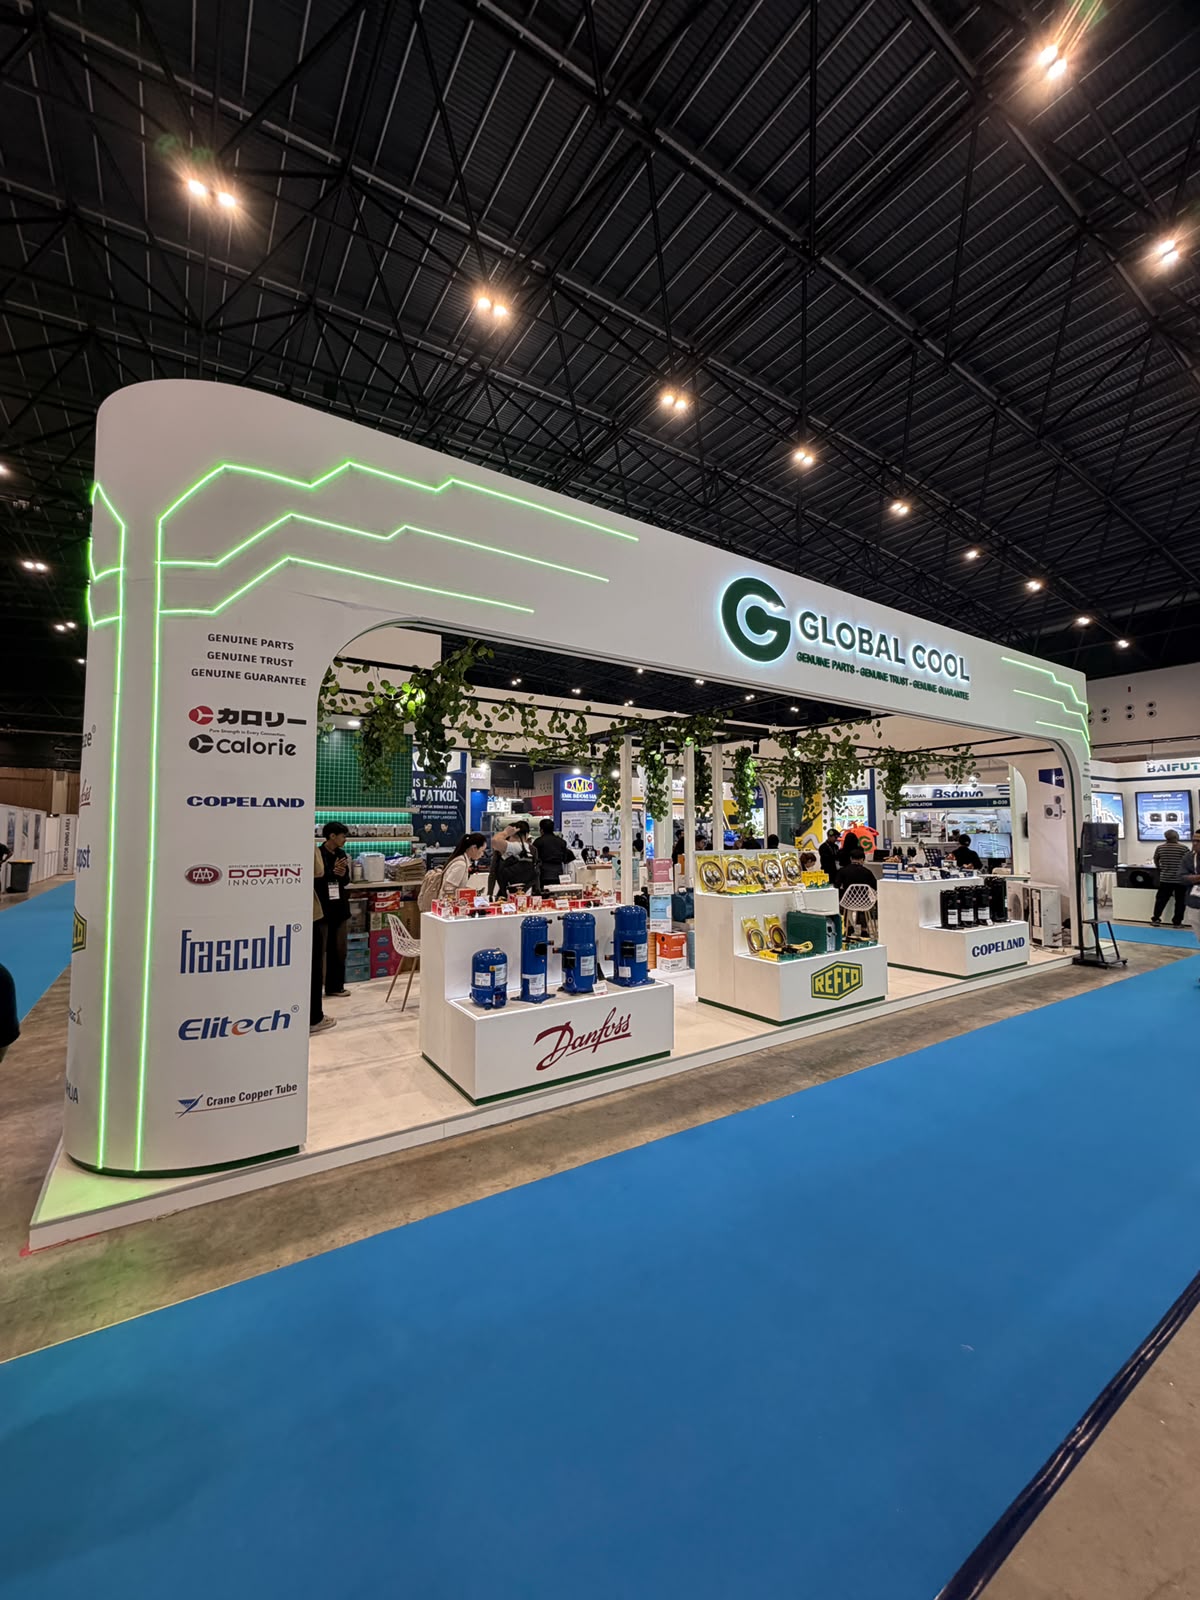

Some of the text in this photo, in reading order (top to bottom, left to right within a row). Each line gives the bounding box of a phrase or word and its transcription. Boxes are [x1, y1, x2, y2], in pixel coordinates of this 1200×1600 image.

[207, 633, 294, 651] GENUINE PARTS
[799, 611, 970, 682] GLOBAL COOL
[207, 651, 294, 668] GENUINE TRUST
[191, 668, 307, 686] GENUINE GUARANTEE
[796, 651, 830, 668] GENUINE
[831, 660, 855, 674] PARTS
[860, 667, 888, 683] GENUINE
[889, 674, 909, 687] TRUST
[912, 679, 937, 693] GENUINE
[938, 685, 970, 700] GUARANTEE
[216, 708, 307, 728] カロリー
[216, 737, 296, 756] Calorie
[186, 796, 305, 808] COPELAND
[420, 789, 459, 802] PATKOL
[228, 868, 301, 878] DORIN
[228, 877, 301, 886] INNOVATION
[971, 936, 1025, 957] COPELAND
[815, 967, 859, 994] REFCO
[533, 1006, 632, 1071] Danfoss
[206, 1083, 298, 1107] Crane Copper Tube
